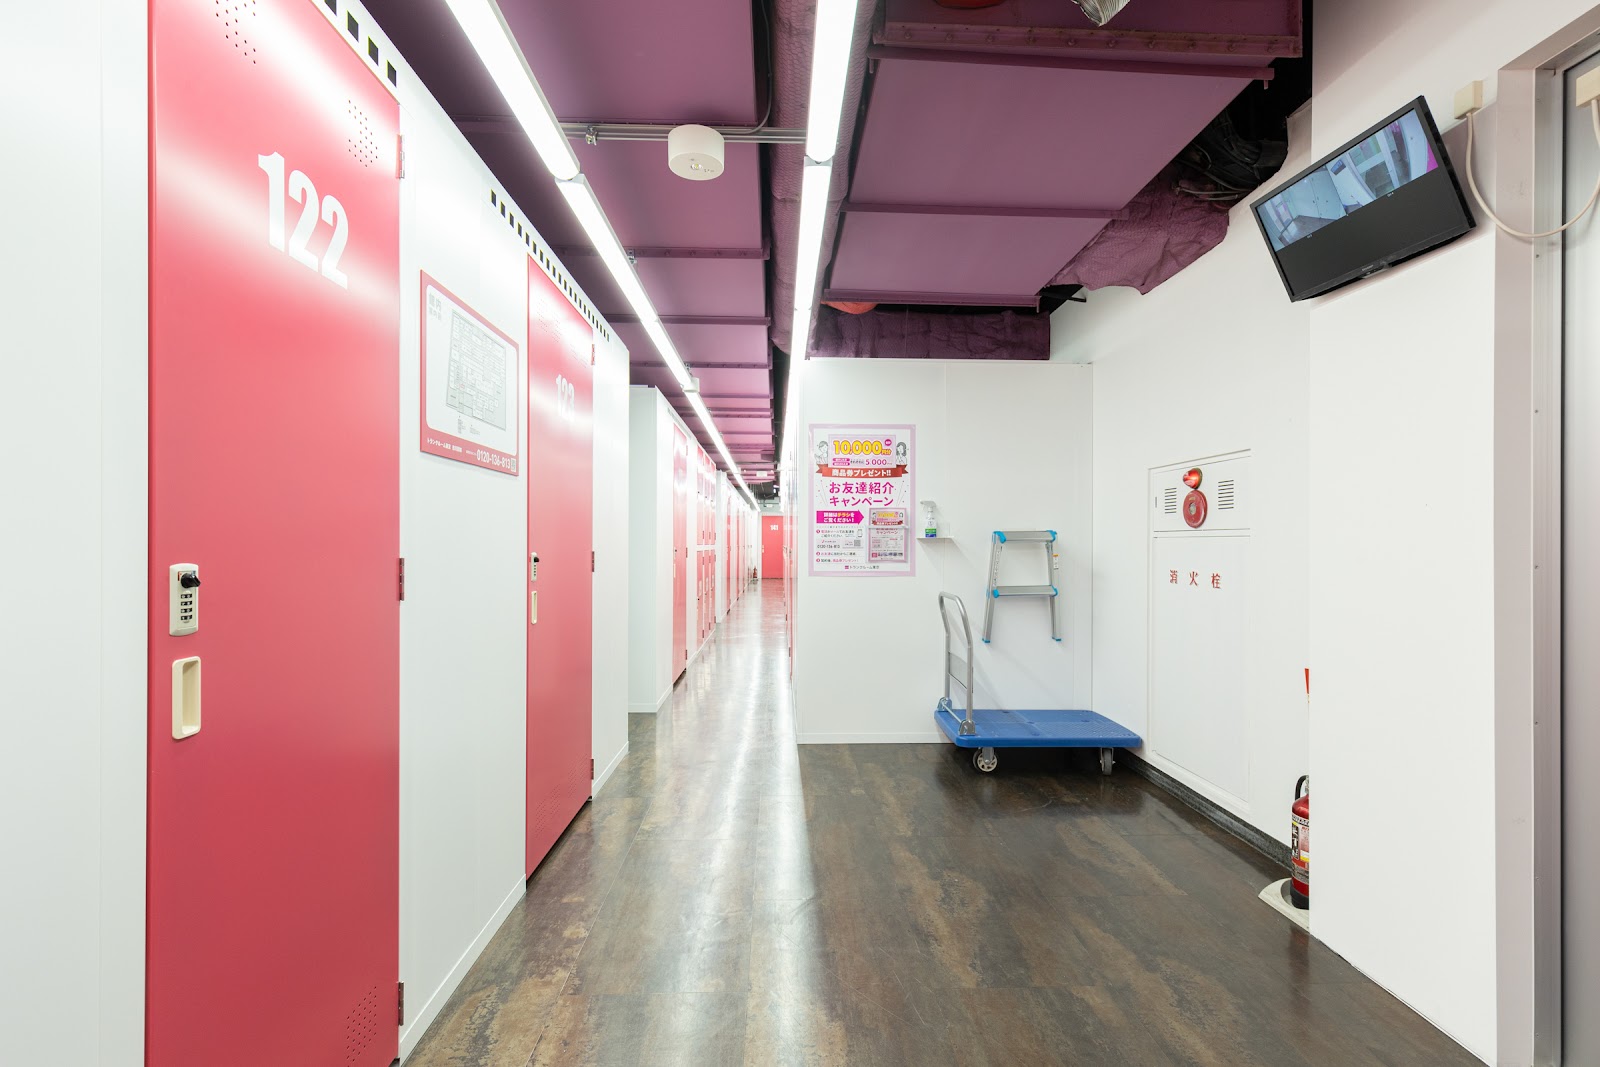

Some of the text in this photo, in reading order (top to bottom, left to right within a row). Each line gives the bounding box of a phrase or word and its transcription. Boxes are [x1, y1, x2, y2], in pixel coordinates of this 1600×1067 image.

[257, 151, 349, 290] 122
[476, 449, 511, 470] 0120-136-813
[829, 481, 895, 495] お友達紹介
[829, 495, 894, 507] キャンペーン
[1169, 569, 1222, 590] 消火栓
